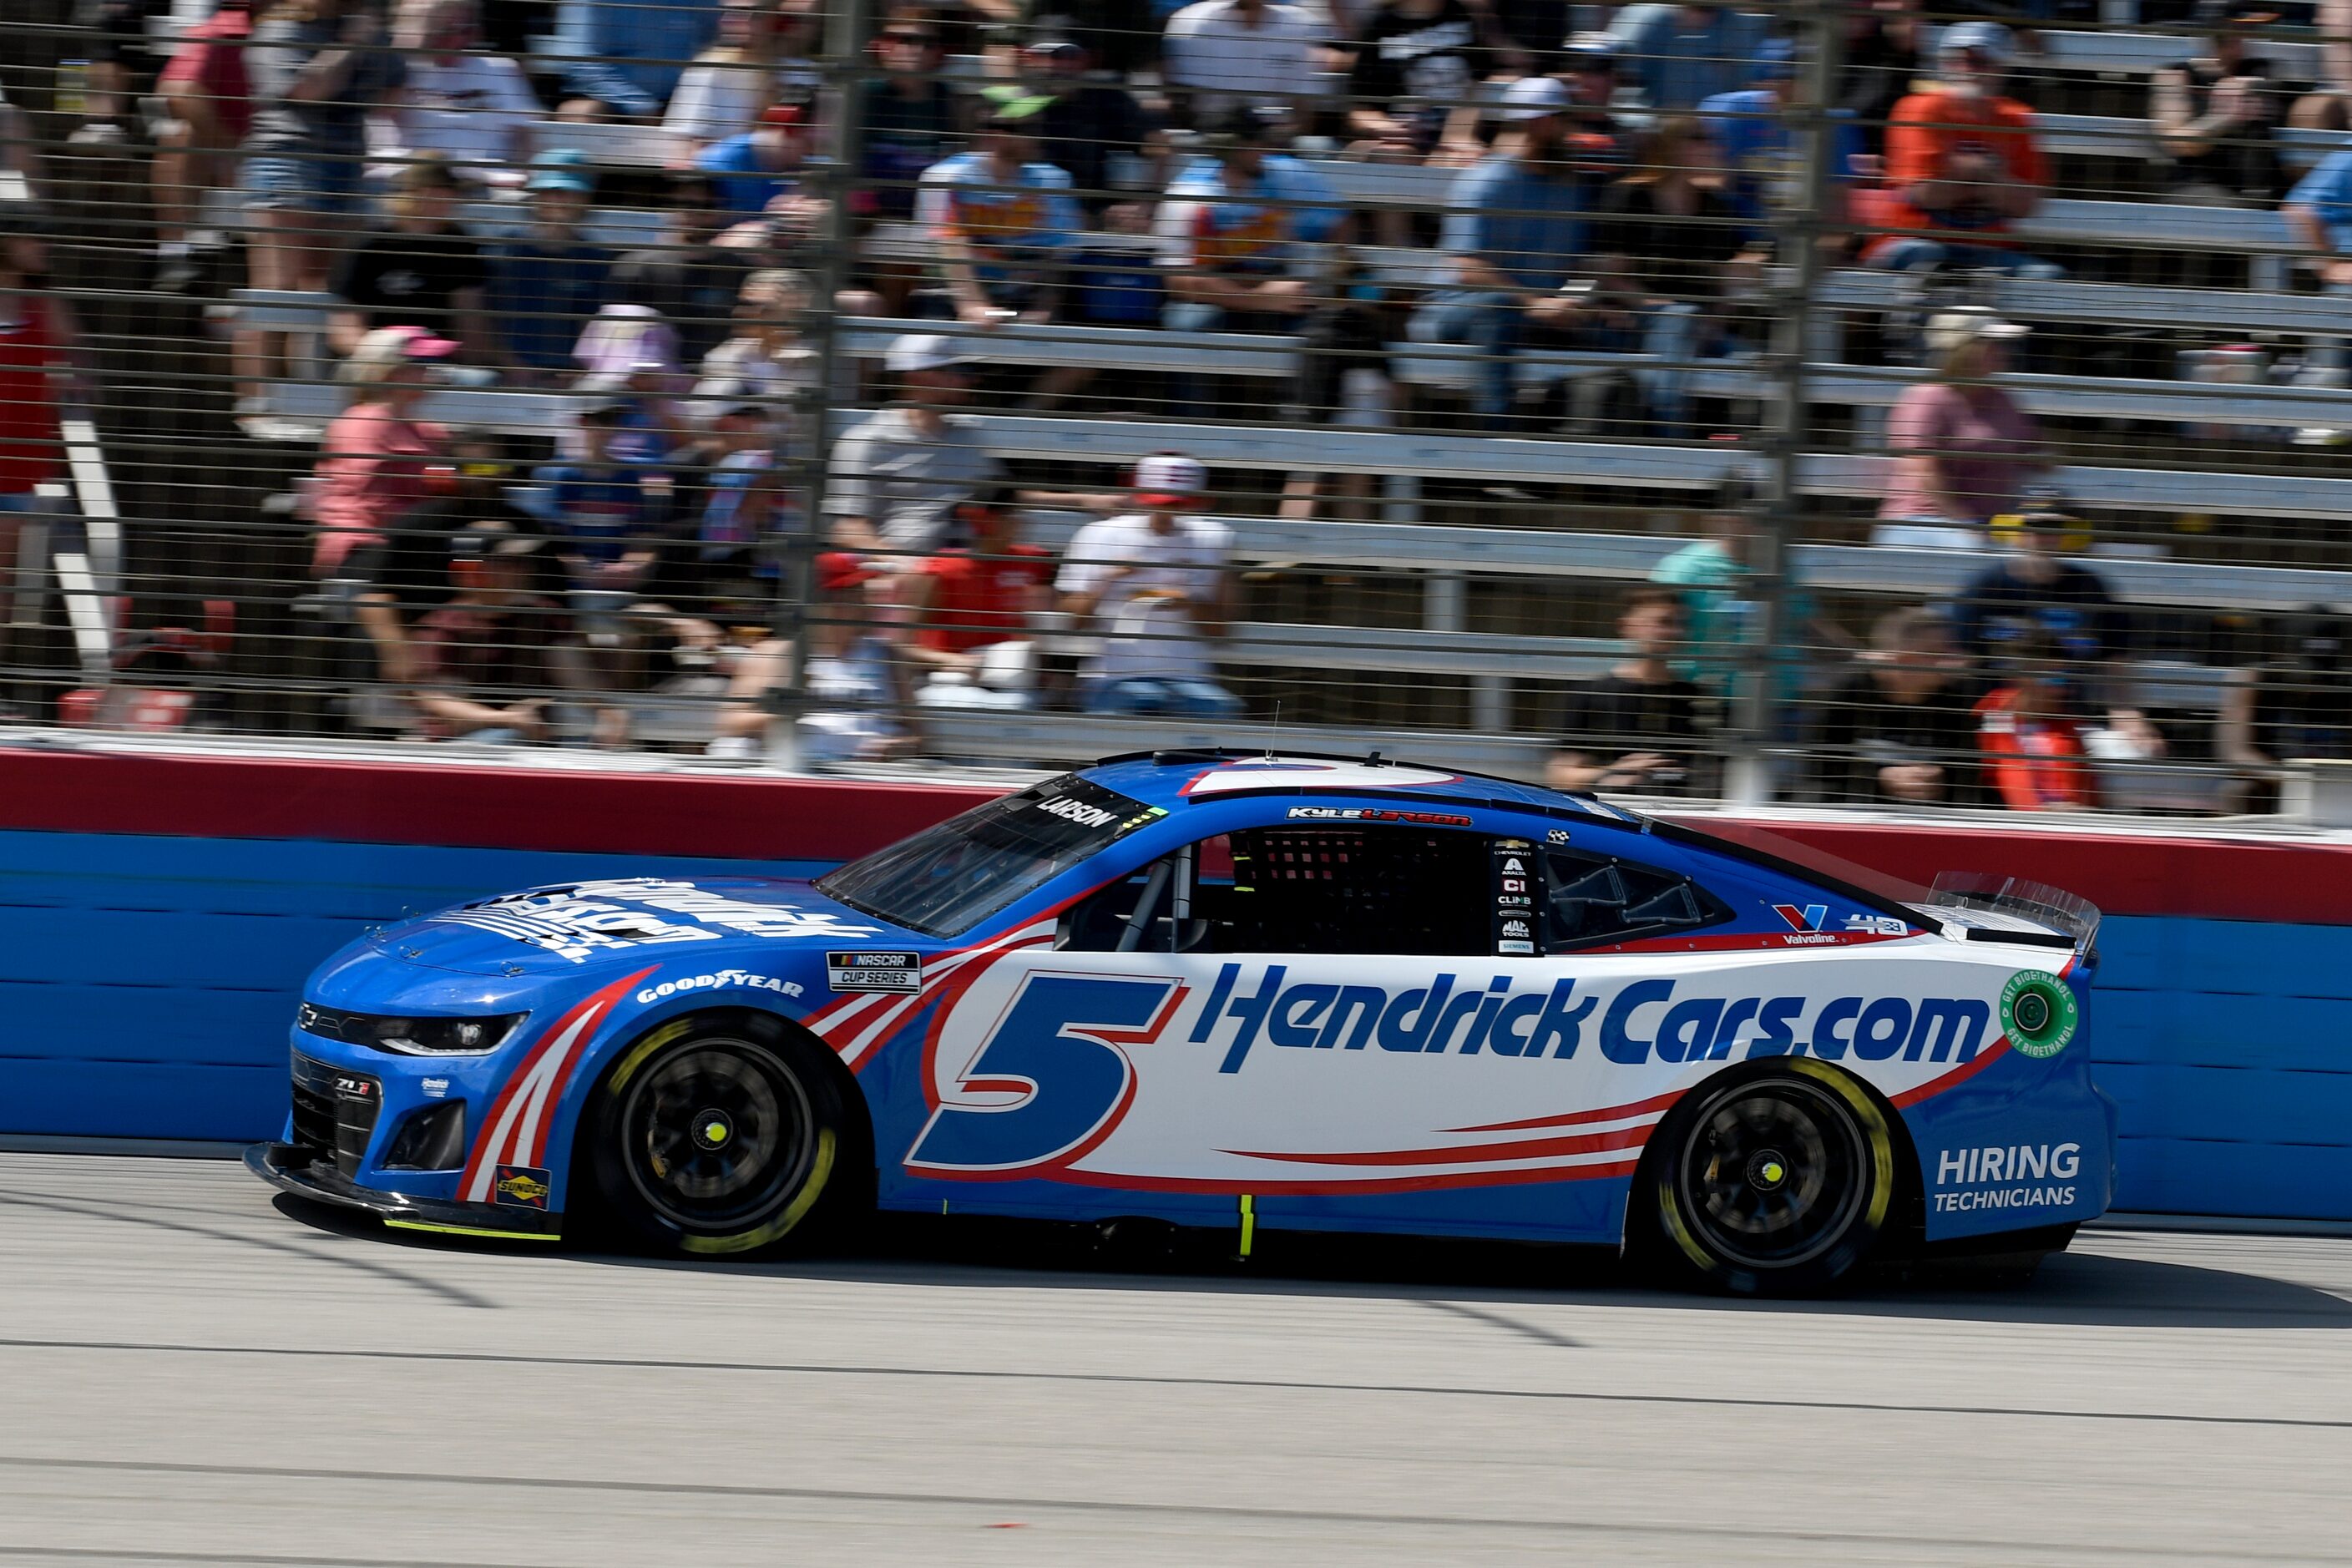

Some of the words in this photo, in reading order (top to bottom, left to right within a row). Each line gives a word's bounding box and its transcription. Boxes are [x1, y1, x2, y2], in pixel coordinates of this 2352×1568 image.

[1036, 795, 1119, 828] LARSON
[1503, 878, 1526, 893] CI
[1502, 919, 1530, 933] MAC
[1783, 933, 1837, 945] Valvoline
[856, 954, 908, 967] NASCAR
[636, 969, 805, 1004] GOODYEAR
[841, 971, 873, 984] CUP
[873, 971, 908, 984] SERIES
[2002, 983, 2016, 1002] GET
[2014, 971, 2071, 1001] BIOETHANOL
[2007, 1028, 2024, 1046] GET
[2022, 1024, 2074, 1055] BIOETHANOL
[903, 969, 1191, 1179] 5
[1936, 1142, 2081, 1185] HIRING
[498, 1180, 549, 1196] SUNOCO
[1935, 1186, 2076, 1211] TECHNICIANS
